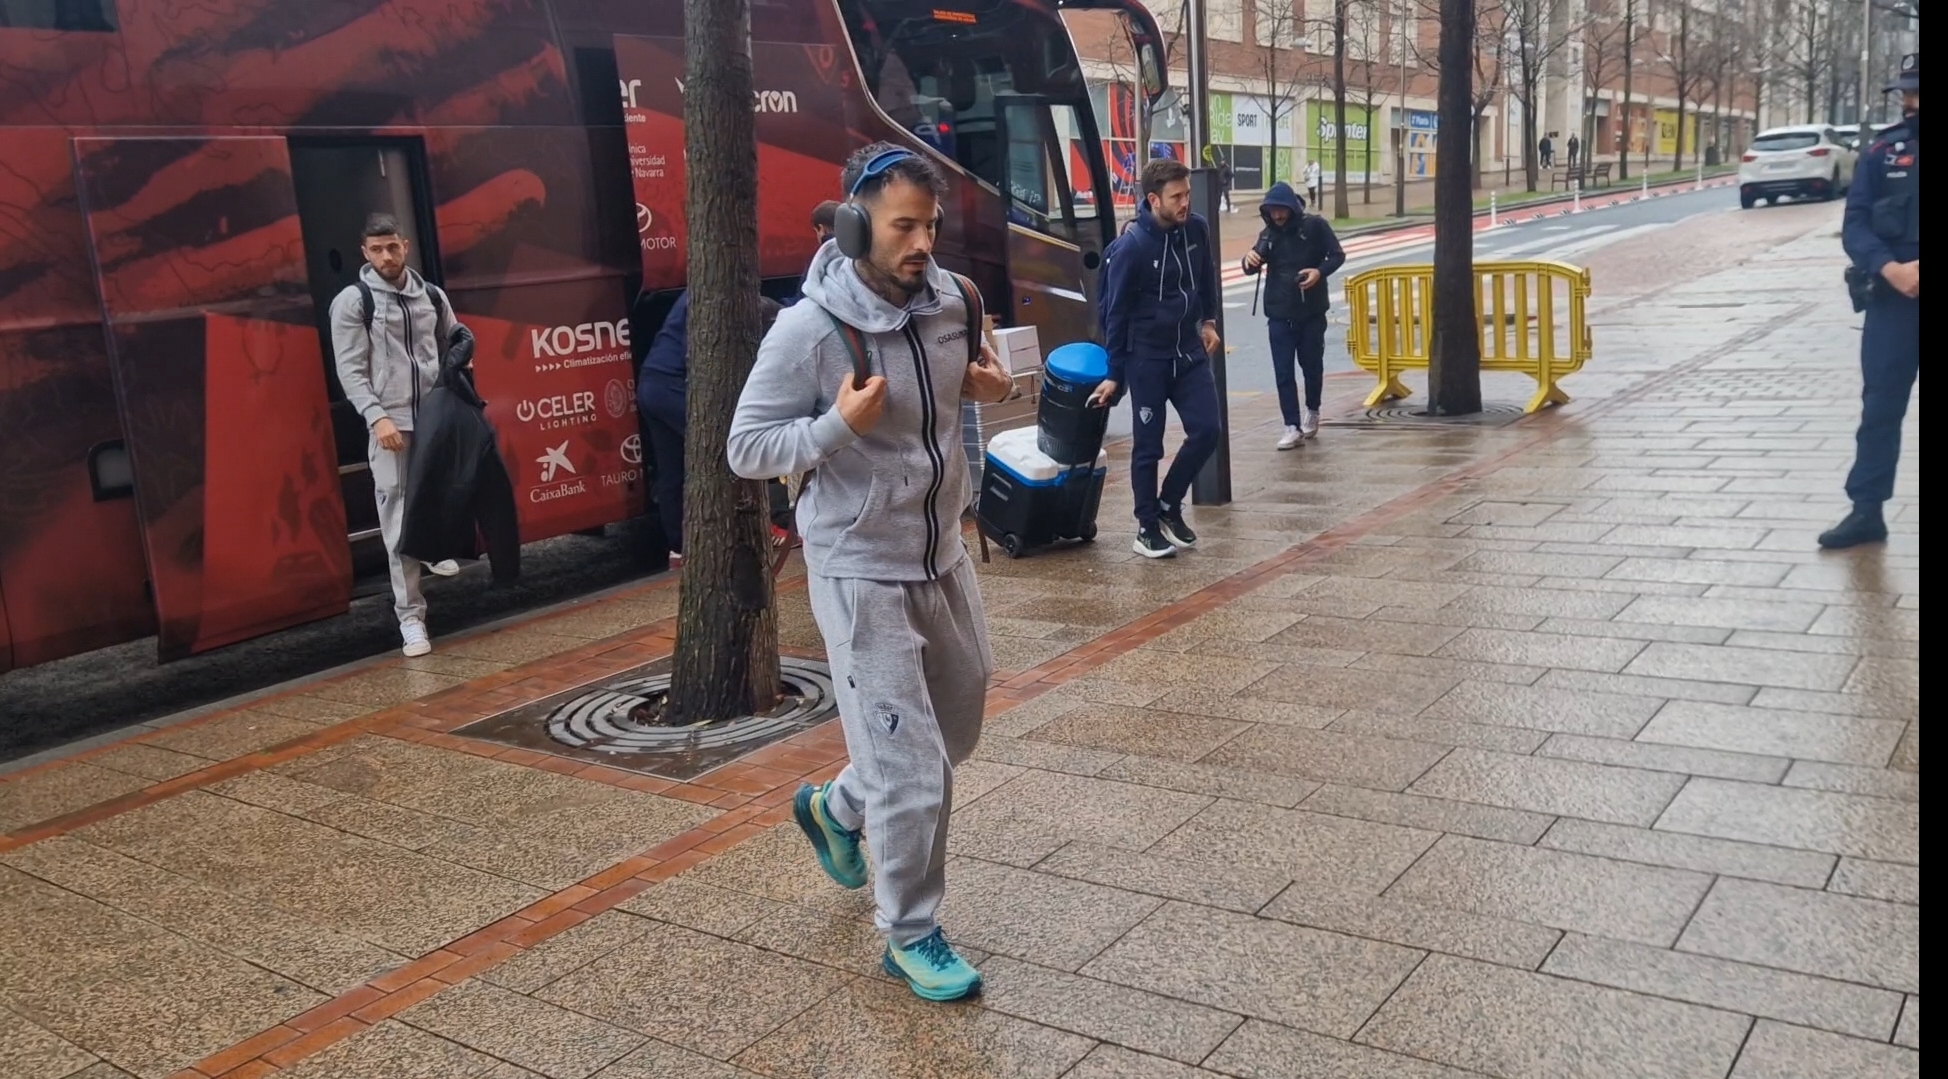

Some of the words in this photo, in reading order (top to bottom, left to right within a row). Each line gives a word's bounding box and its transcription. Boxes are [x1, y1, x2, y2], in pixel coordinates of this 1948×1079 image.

[1237, 113, 1258, 128] SPORT
[635, 168, 664, 178] Navarra
[564, 355, 618, 369] Climatización
[537, 391, 596, 418] CELER
[601, 469, 637, 486] TAURO
[530, 481, 586, 503] CaixaBank
